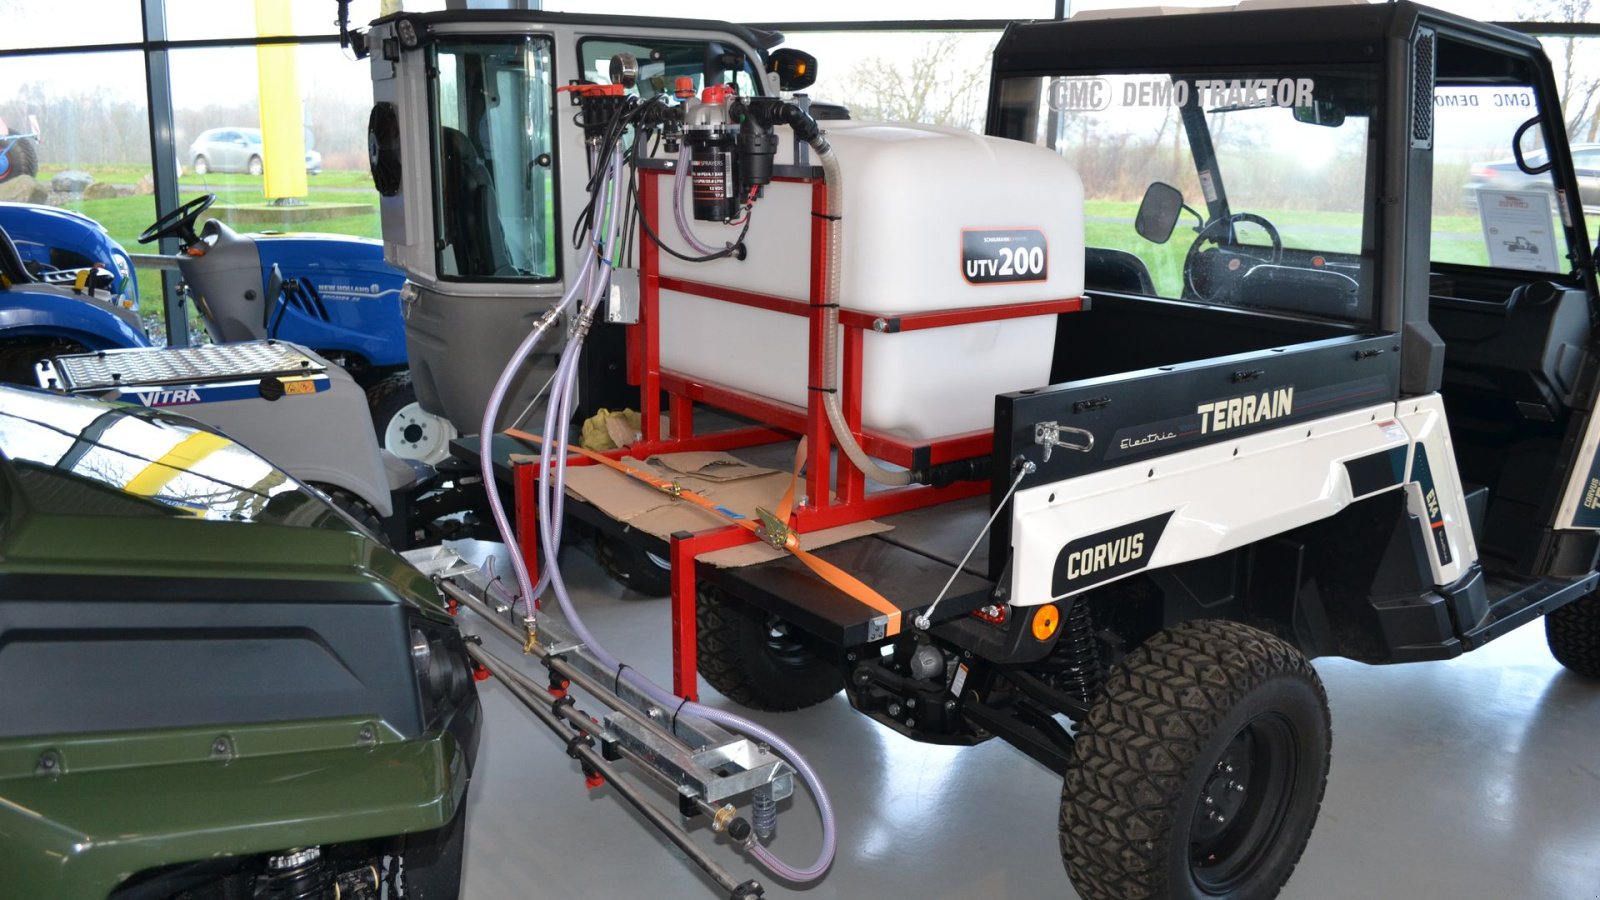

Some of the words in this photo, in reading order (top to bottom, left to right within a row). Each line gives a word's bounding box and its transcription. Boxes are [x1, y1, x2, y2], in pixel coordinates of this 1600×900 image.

[1054, 81, 1103, 109] GMC
[1122, 80, 1189, 107] DEMO
[1195, 78, 1315, 108] TRAKTOR
[337, 285, 370, 294] HOLLAND
[137, 389, 201, 408] VITRA
[1197, 387, 1294, 435] TERRAIN
[1120, 432, 1177, 450] Electric
[1426, 488, 1440, 518] EX4
[1067, 532, 1144, 580] CORVUS
